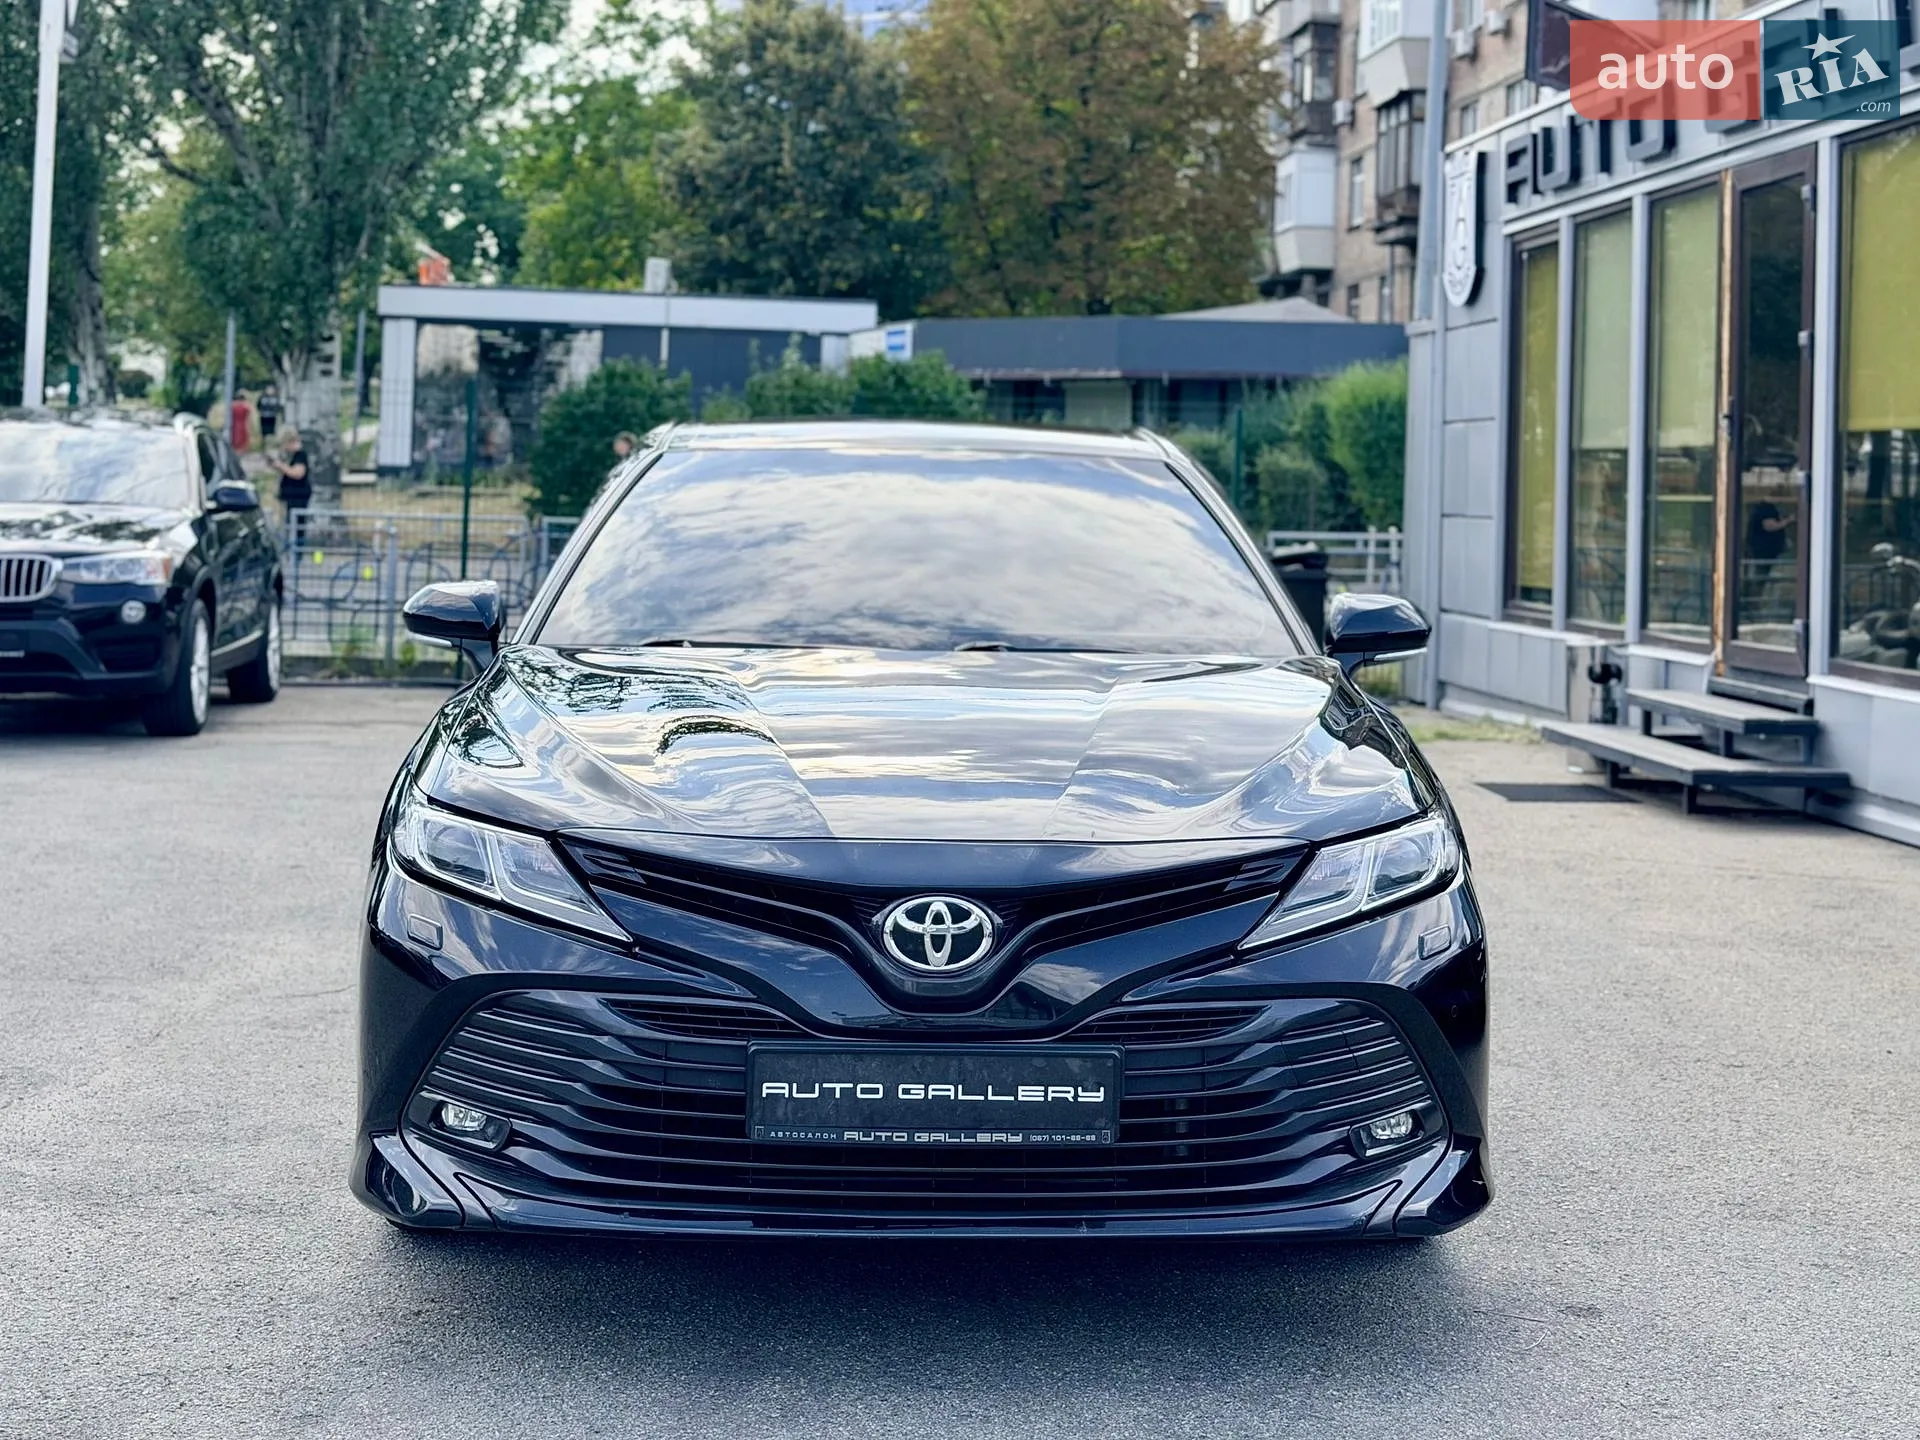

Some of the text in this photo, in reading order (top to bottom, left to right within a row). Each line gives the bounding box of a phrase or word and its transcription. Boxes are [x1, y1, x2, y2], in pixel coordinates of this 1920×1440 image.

[762, 1082, 1105, 1103] AUTO GALLERY
[769, 1130, 837, 1140] АВТОСАЛОН
[843, 1131, 908, 1142] AUTO
[914, 1132, 1023, 1143] GALLERY
